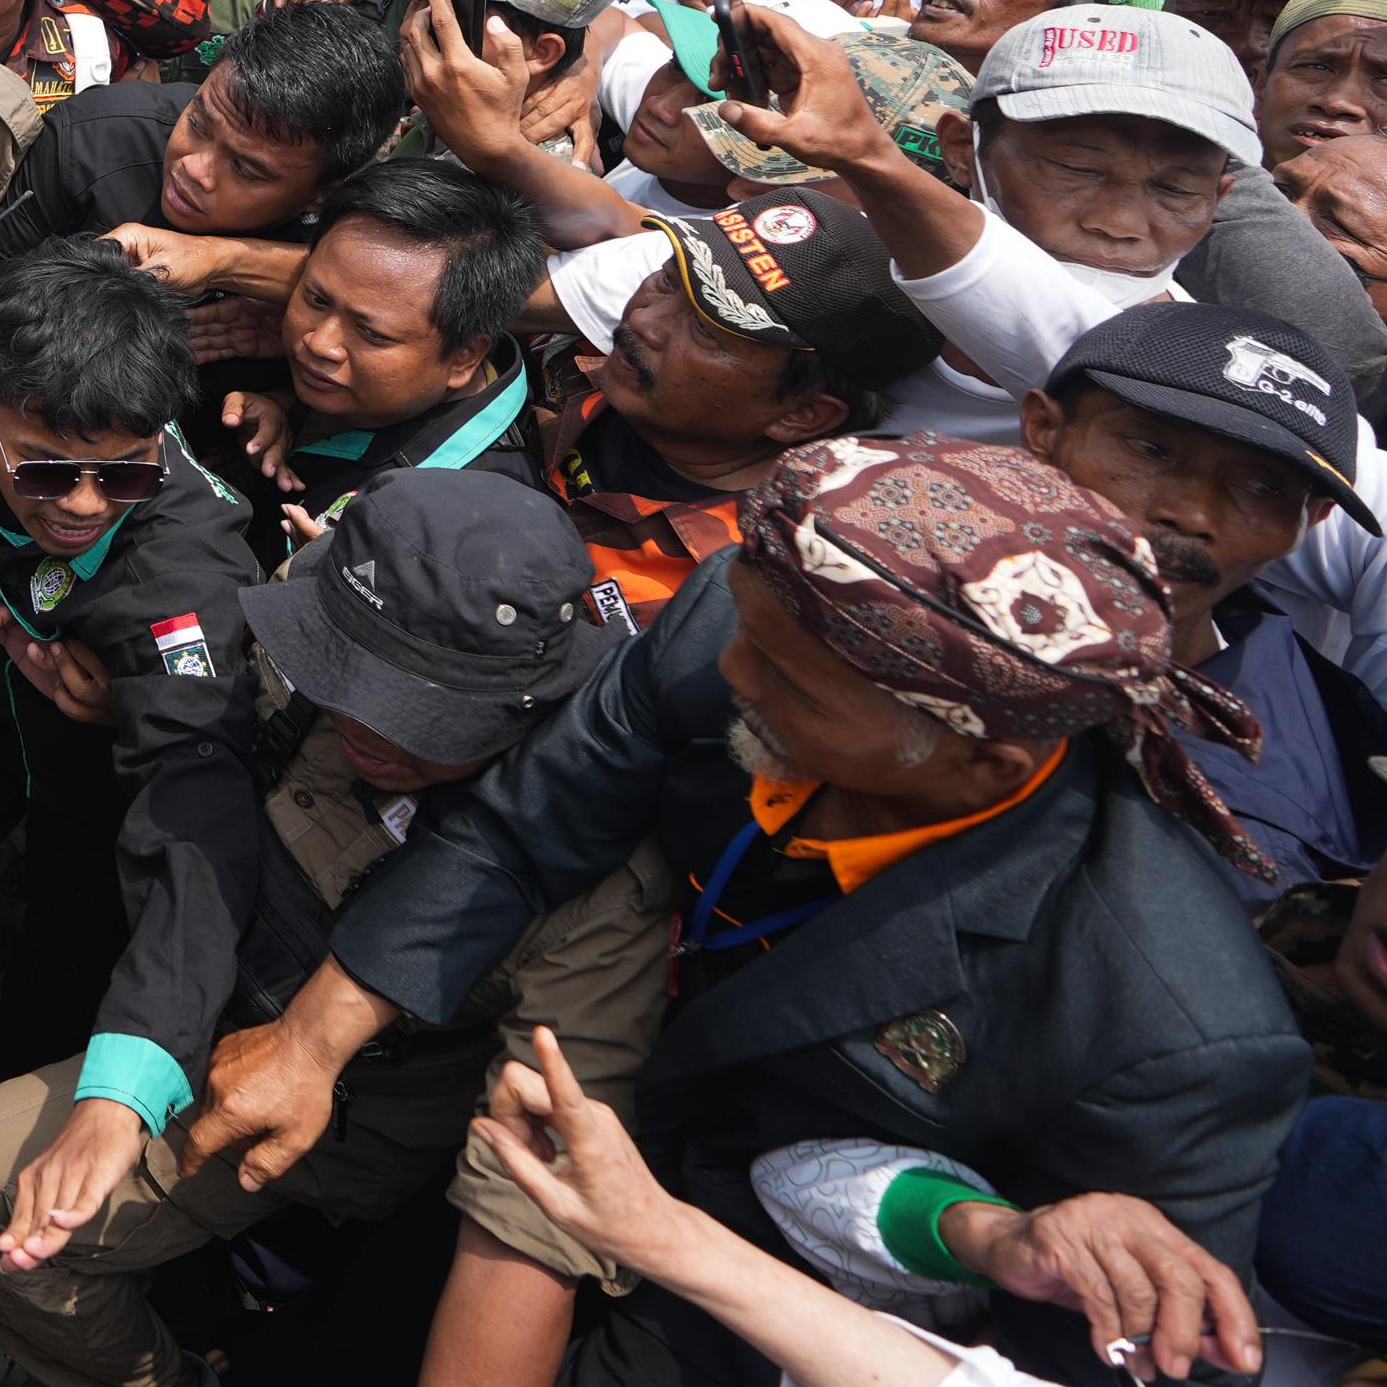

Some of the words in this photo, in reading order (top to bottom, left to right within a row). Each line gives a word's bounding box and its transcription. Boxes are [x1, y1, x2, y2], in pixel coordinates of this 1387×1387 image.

[1058, 28, 1140, 53] USED
[897, 131, 940, 156] PK
[342, 565, 383, 611] EIGER
